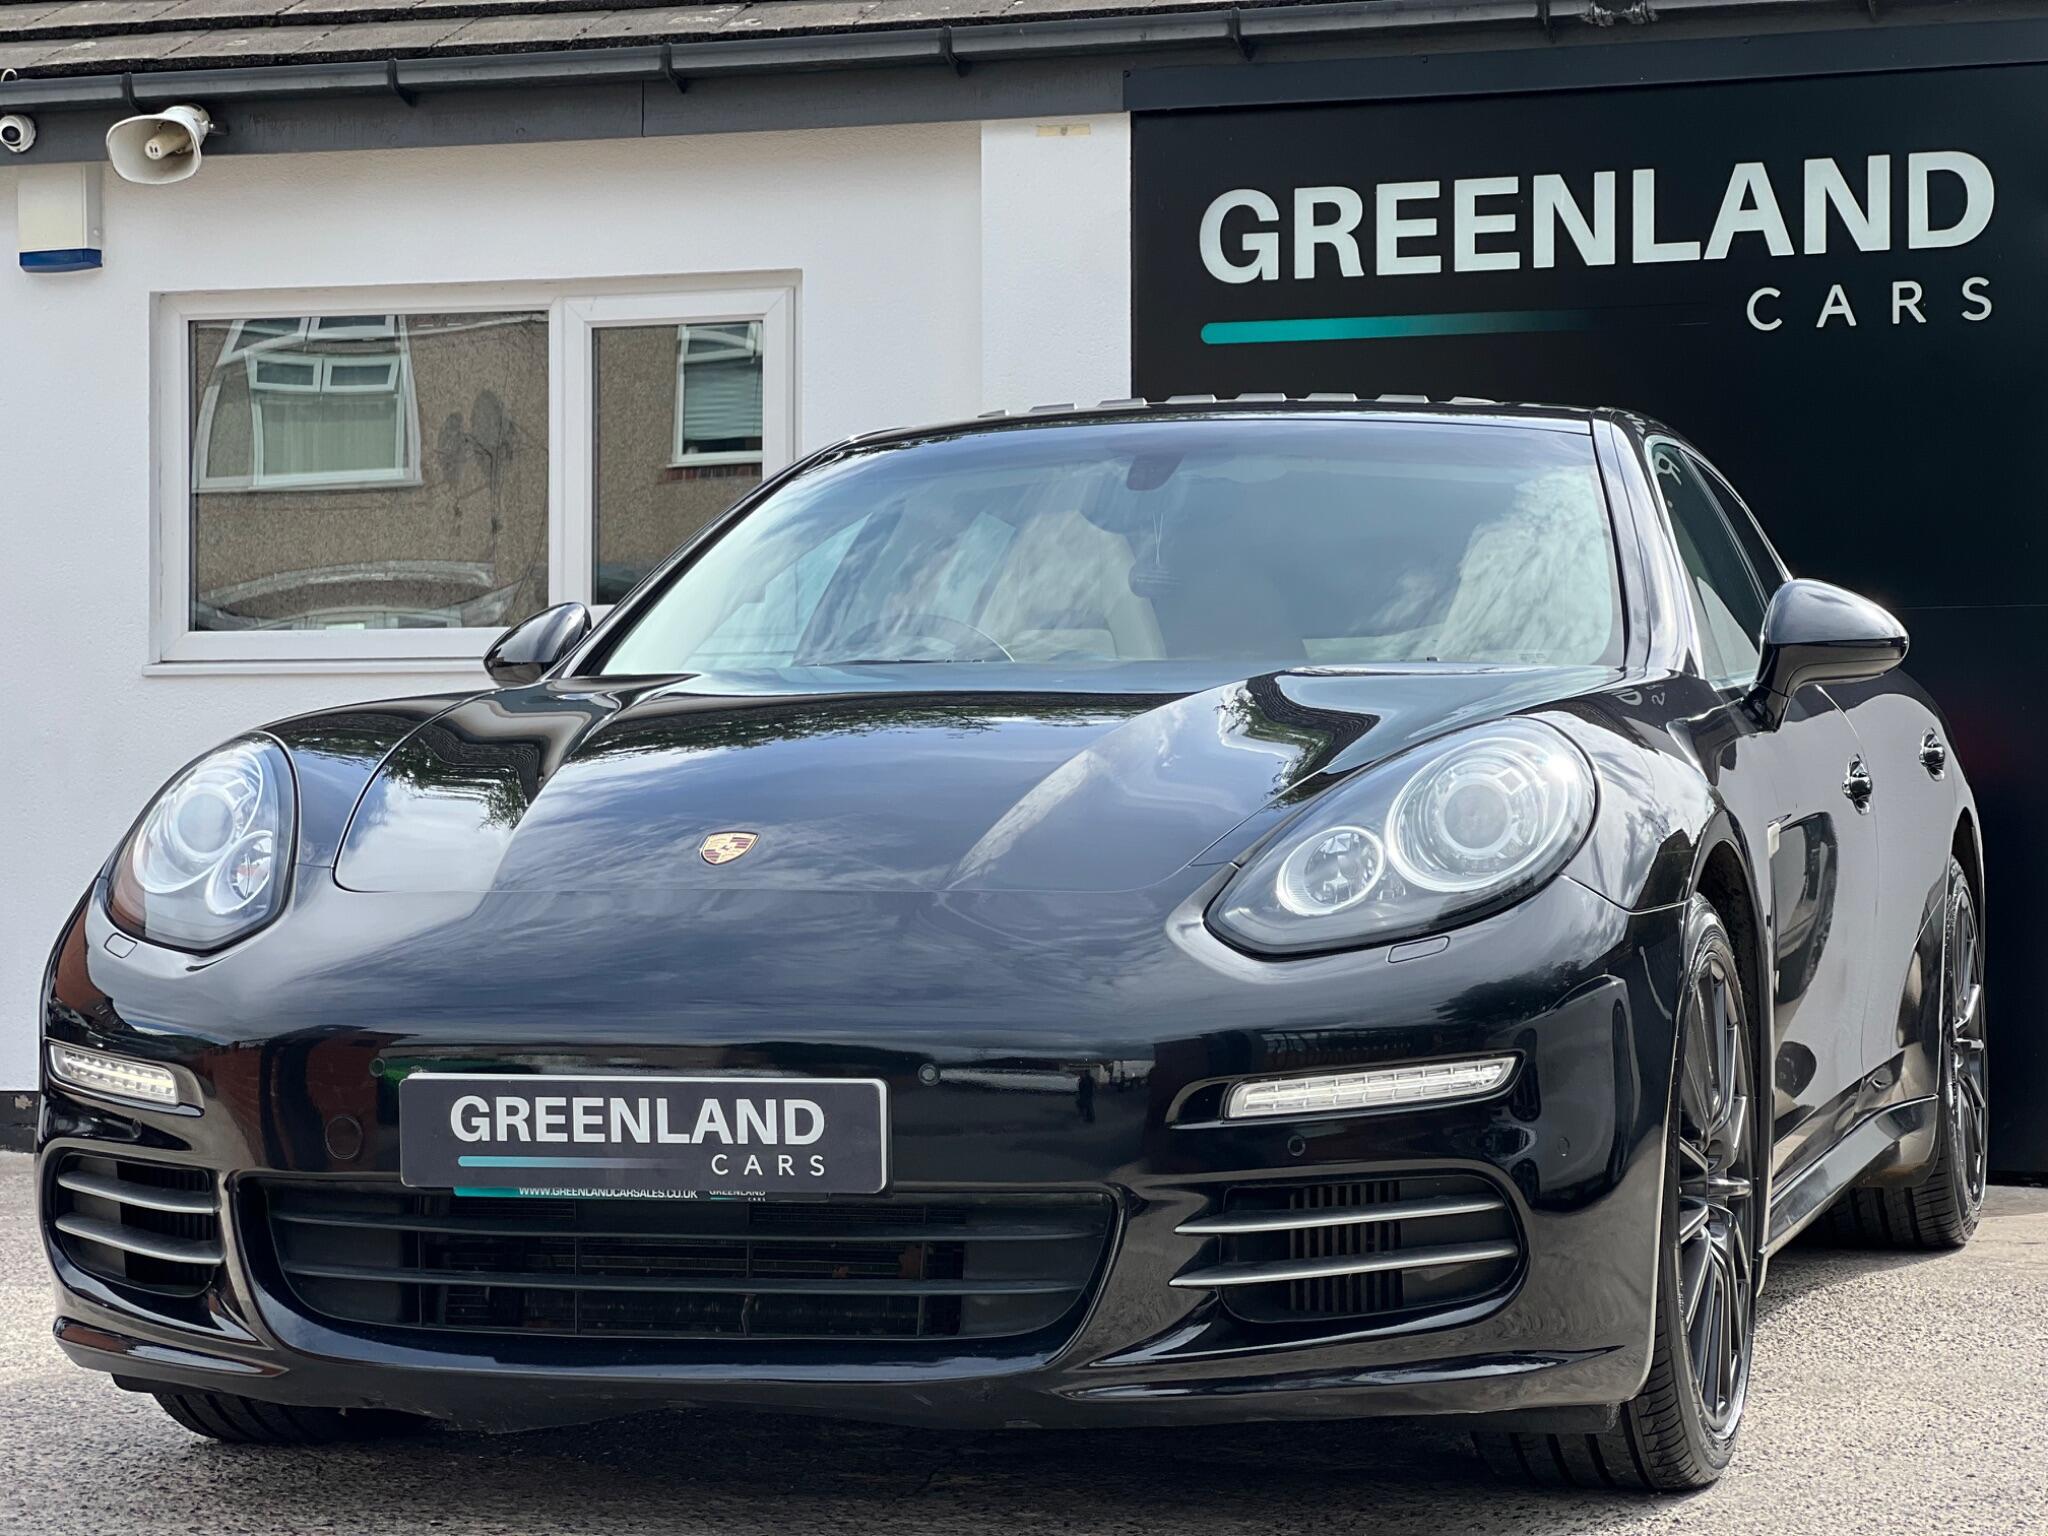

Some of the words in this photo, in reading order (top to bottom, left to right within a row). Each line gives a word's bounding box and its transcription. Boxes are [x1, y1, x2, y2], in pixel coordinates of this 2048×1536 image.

[1199, 151, 1995, 284] GREENLAND
[1746, 276, 1992, 331] CARS
[450, 1095, 825, 1145] GREENLAND
[711, 1153, 825, 1177] CARS
